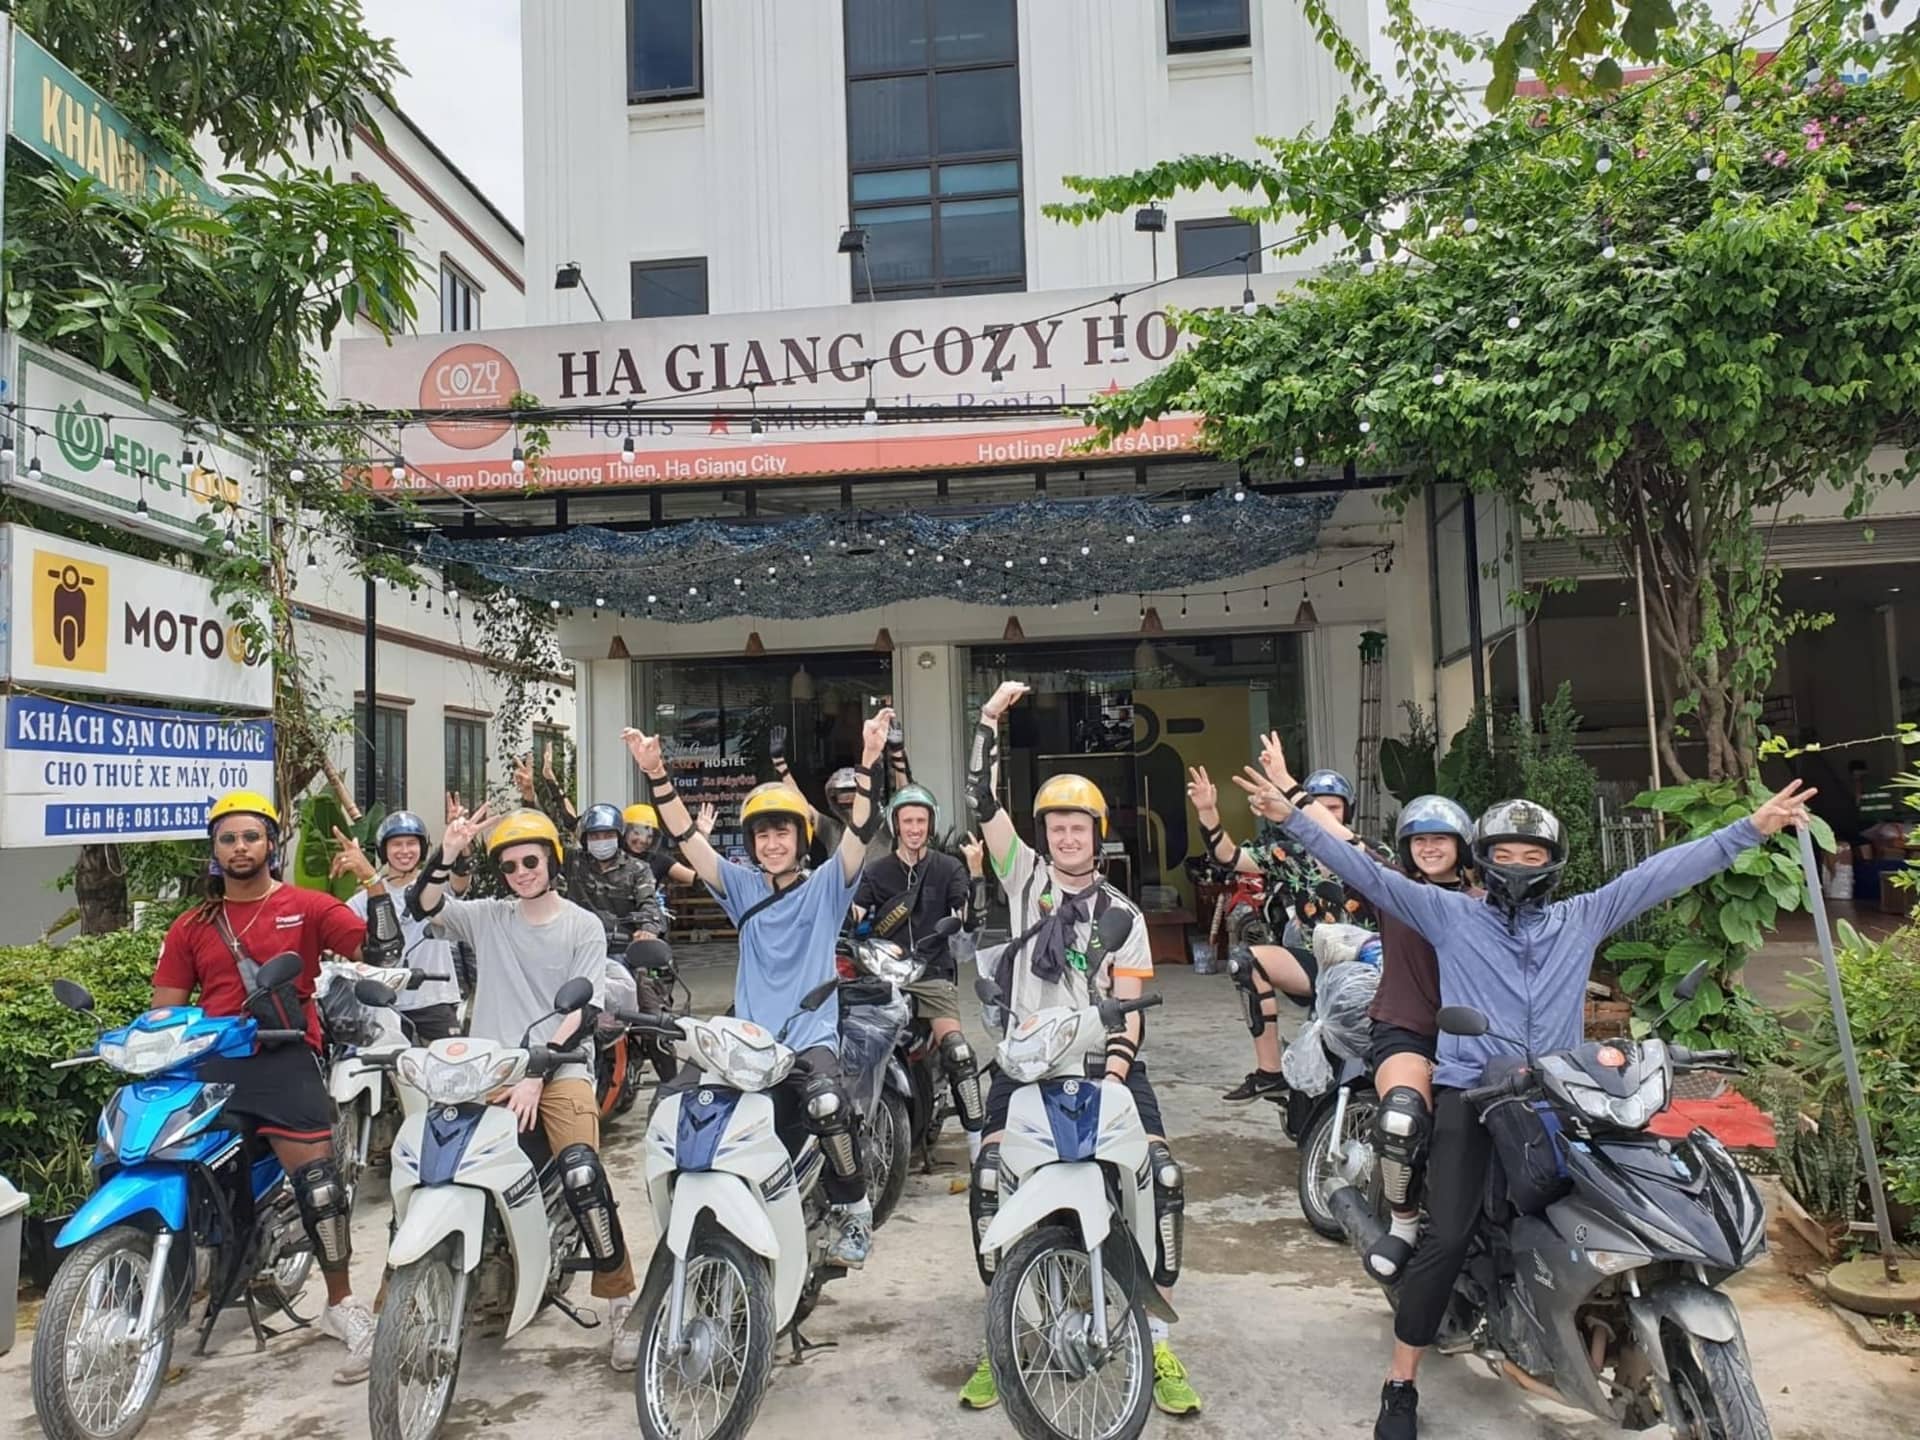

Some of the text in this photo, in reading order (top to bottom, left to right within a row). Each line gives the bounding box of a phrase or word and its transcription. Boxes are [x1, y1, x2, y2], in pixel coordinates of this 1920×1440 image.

[558, 307, 1212, 400] HA GIANG COZY HO
[436, 360, 501, 396] COZY
[114, 434, 172, 492] EPIC
[436, 471, 475, 489] Lam
[477, 469, 529, 488] Dong,
[606, 461, 661, 480] Thien,
[664, 460, 690, 477] Ha
[694, 457, 747, 476] Giang
[751, 455, 787, 473] City
[18, 705, 105, 746] KHÁCH
[111, 717, 155, 755] SẠN
[160, 715, 201, 751] CÒN
[44, 760, 87, 787] CHO
[93, 758, 143, 788] THUÊ
[150, 765, 171, 788] XE
[176, 760, 214, 789] MÁY,
[703, 756, 747, 769] HOSTEL
[673, 776, 699, 787] Tour
[64, 807, 101, 830] Liên
[105, 806, 131, 833] Hệ:
